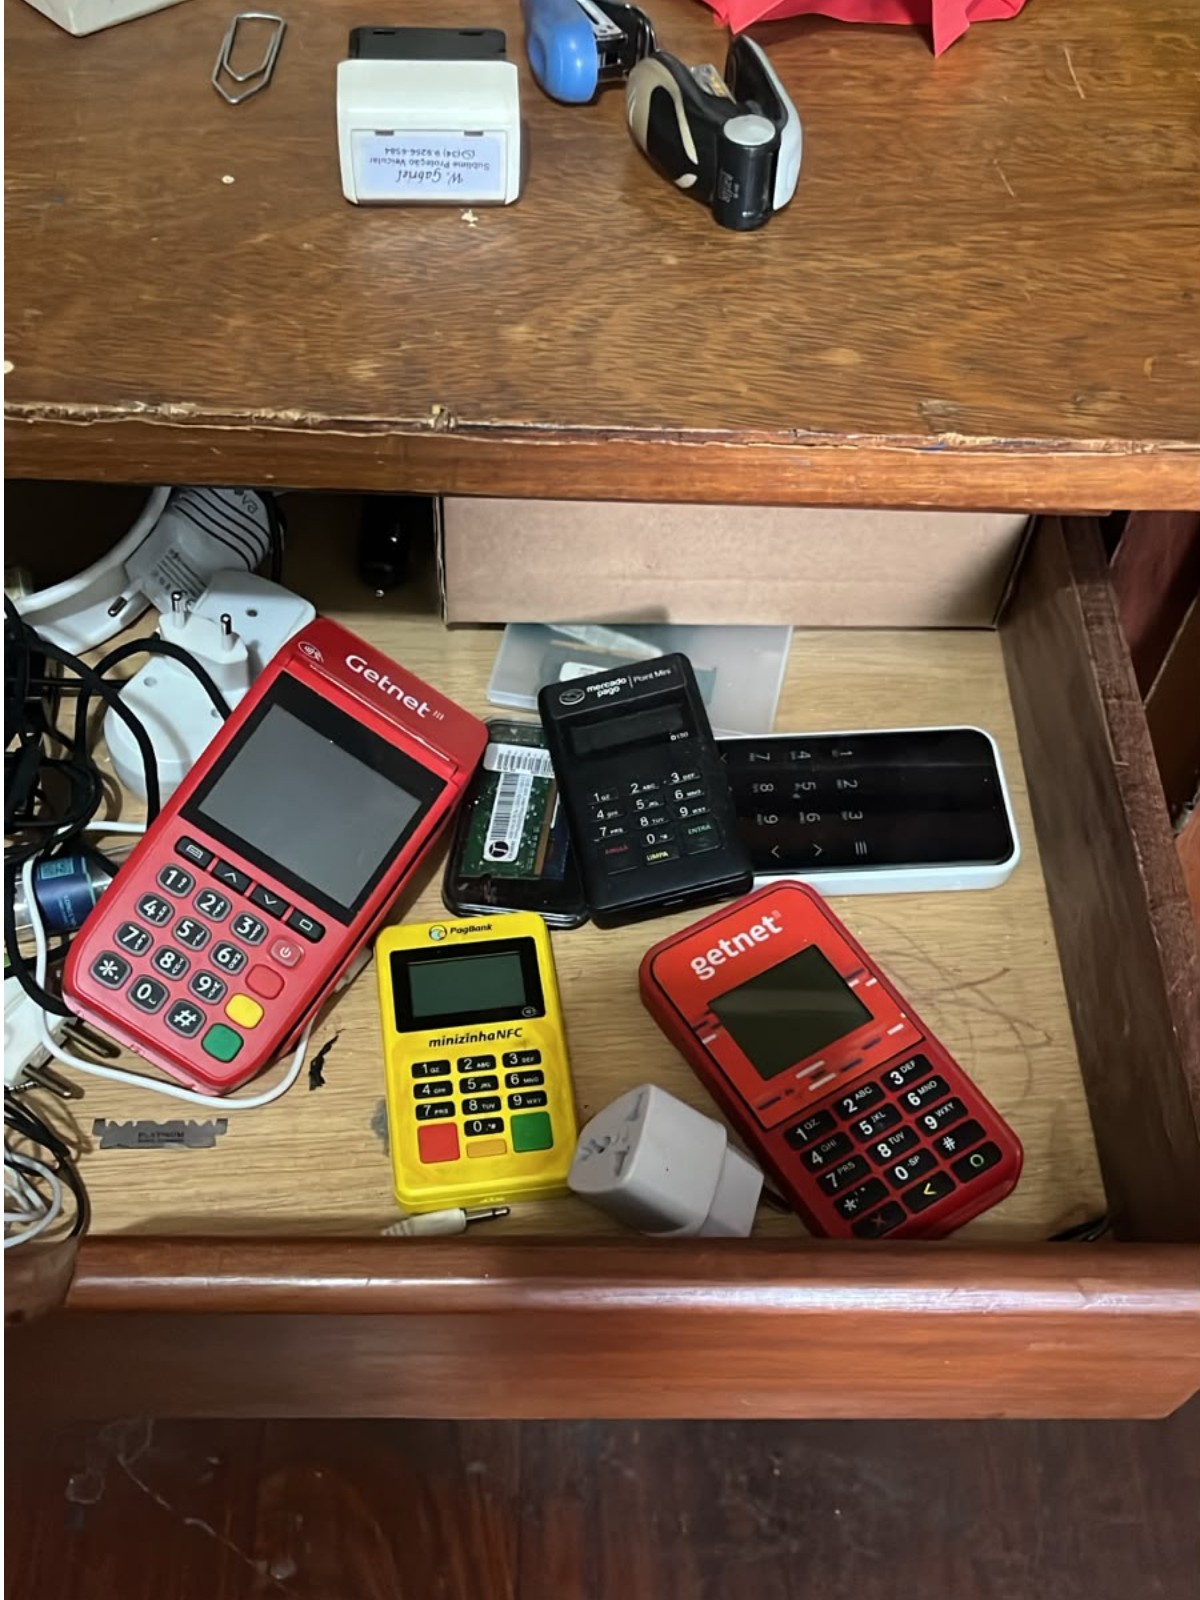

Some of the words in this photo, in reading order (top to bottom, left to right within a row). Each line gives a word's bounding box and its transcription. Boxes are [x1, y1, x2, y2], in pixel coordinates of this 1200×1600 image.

[452, 160, 490, 170] Sublime
[395, 168, 441, 184] Gabriel
[345, 654, 431, 718] Getnet
[586, 677, 627, 693] mercado
[597, 686, 620, 698] pago
[755, 752, 771, 761] 7
[670, 772, 680, 783] 3
[630, 783, 640, 794] 2
[759, 783, 774, 792] 8
[843, 779, 858, 789] 2
[593, 793, 600, 802] 1
[674, 789, 683, 800] 6
[635, 799, 645, 810] 5
[596, 809, 605, 819] 4
[680, 806, 689, 817] 9
[848, 810, 863, 820] 3
[640, 816, 649, 827] 8
[599, 826, 607, 837] 7
[646, 833, 655, 844] 0
[166, 870, 178, 885] 1
[143, 900, 158, 916] 4
[199, 893, 216, 911] 2
[176, 920, 194, 937] 5
[236, 916, 254, 934] 3
[450, 923, 493, 935] PagBank
[122, 926, 140, 942] 7
[690, 916, 783, 980] getnet
[160, 951, 175, 968] 8
[217, 947, 233, 963] 6
[196, 976, 212, 992] 9
[463, 1058, 473, 1070] 2
[509, 1053, 518, 1065] 3
[422, 1063, 428, 1074] 1
[889, 1071, 904, 1085] 3
[899, 1059, 917, 1074] DEF
[467, 1078, 477, 1090] 5
[510, 1073, 520, 1085] 6
[422, 1084, 430, 1095] 4
[907, 1091, 921, 1106] 6
[916, 1080, 938, 1096] MNO
[468, 1099, 478, 1111] 8
[512, 1094, 522, 1106] 9
[843, 1098, 858, 1113] 2
[854, 1086, 873, 1100] ABC
[423, 1104, 432, 1117] 7
[924, 1115, 938, 1131] 9
[934, 1102, 955, 1117] WXY
[472, 1120, 482, 1132] 0
[858, 1120, 873, 1136] 5
[795, 1127, 808, 1141] 1
[876, 1143, 892, 1158] 8
[888, 1131, 906, 1145] TUV
[811, 1150, 824, 1164] 4
[894, 1166, 909, 1181] 0
[825, 1172, 838, 1188] 7
